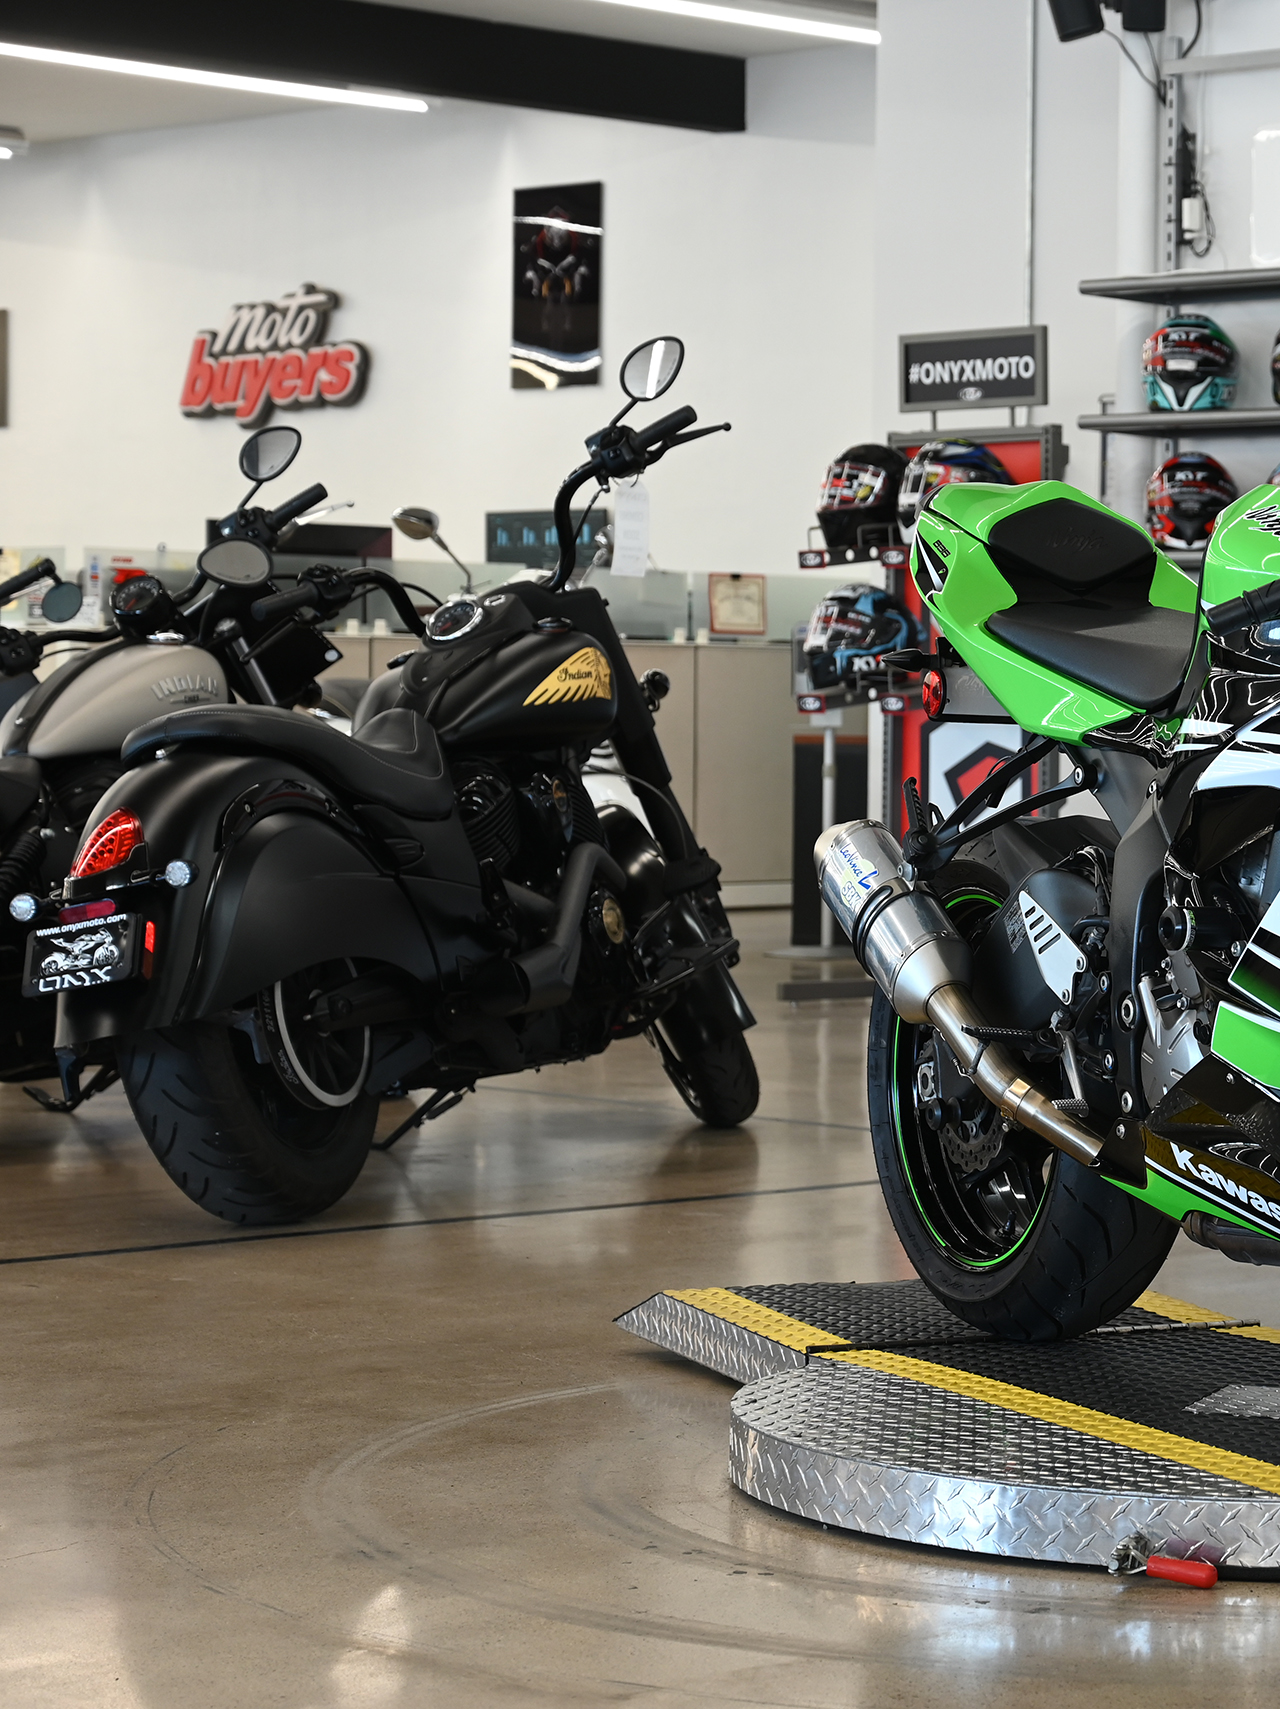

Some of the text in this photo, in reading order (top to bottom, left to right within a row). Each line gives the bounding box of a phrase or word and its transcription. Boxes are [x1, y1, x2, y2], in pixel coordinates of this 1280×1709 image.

[211, 286, 328, 352] Moto
[179, 336, 358, 419] buyers
[908, 355, 1036, 386] #ONYXMOTO
[150, 674, 218, 701] INDIAN
[557, 667, 593, 682] Indian
[36, 914, 127, 937] www.onyxmoto.com
